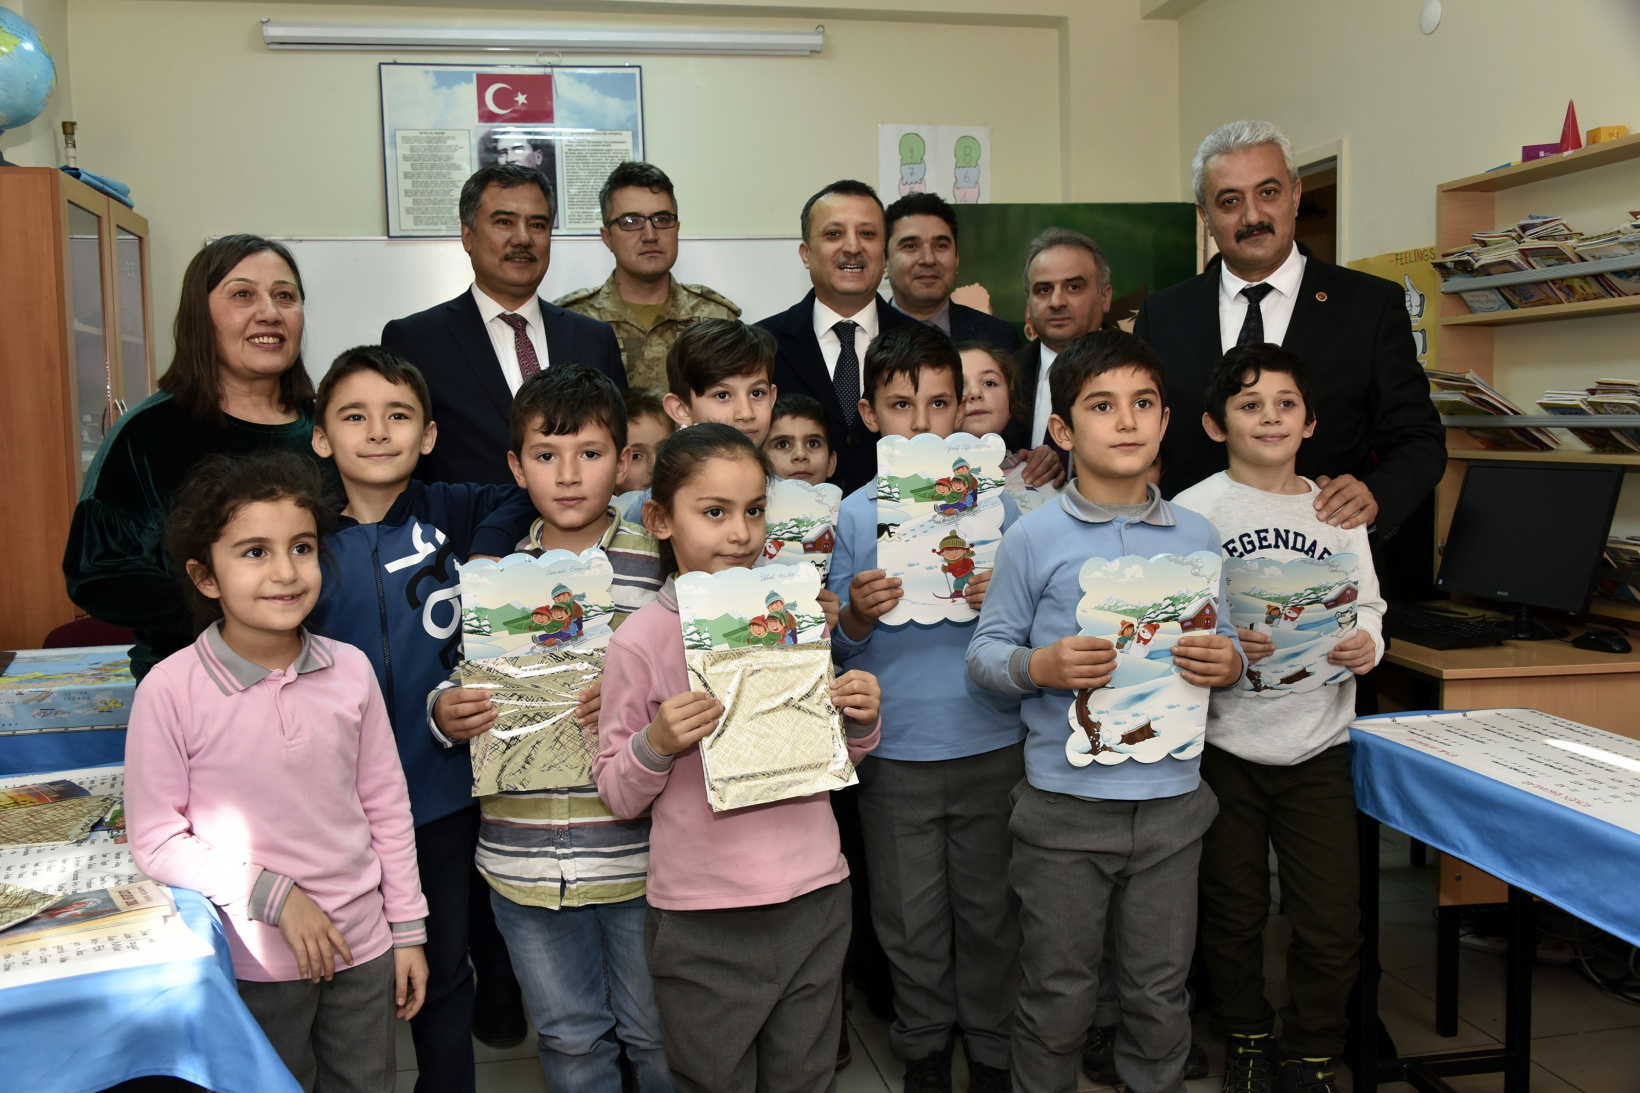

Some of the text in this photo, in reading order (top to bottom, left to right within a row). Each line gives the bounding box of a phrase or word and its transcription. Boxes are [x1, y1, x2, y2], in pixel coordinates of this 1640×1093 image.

[963, 145, 972, 164] 8
[963, 171, 970, 183] 6
[1395, 247, 1436, 266] FEELINGS
